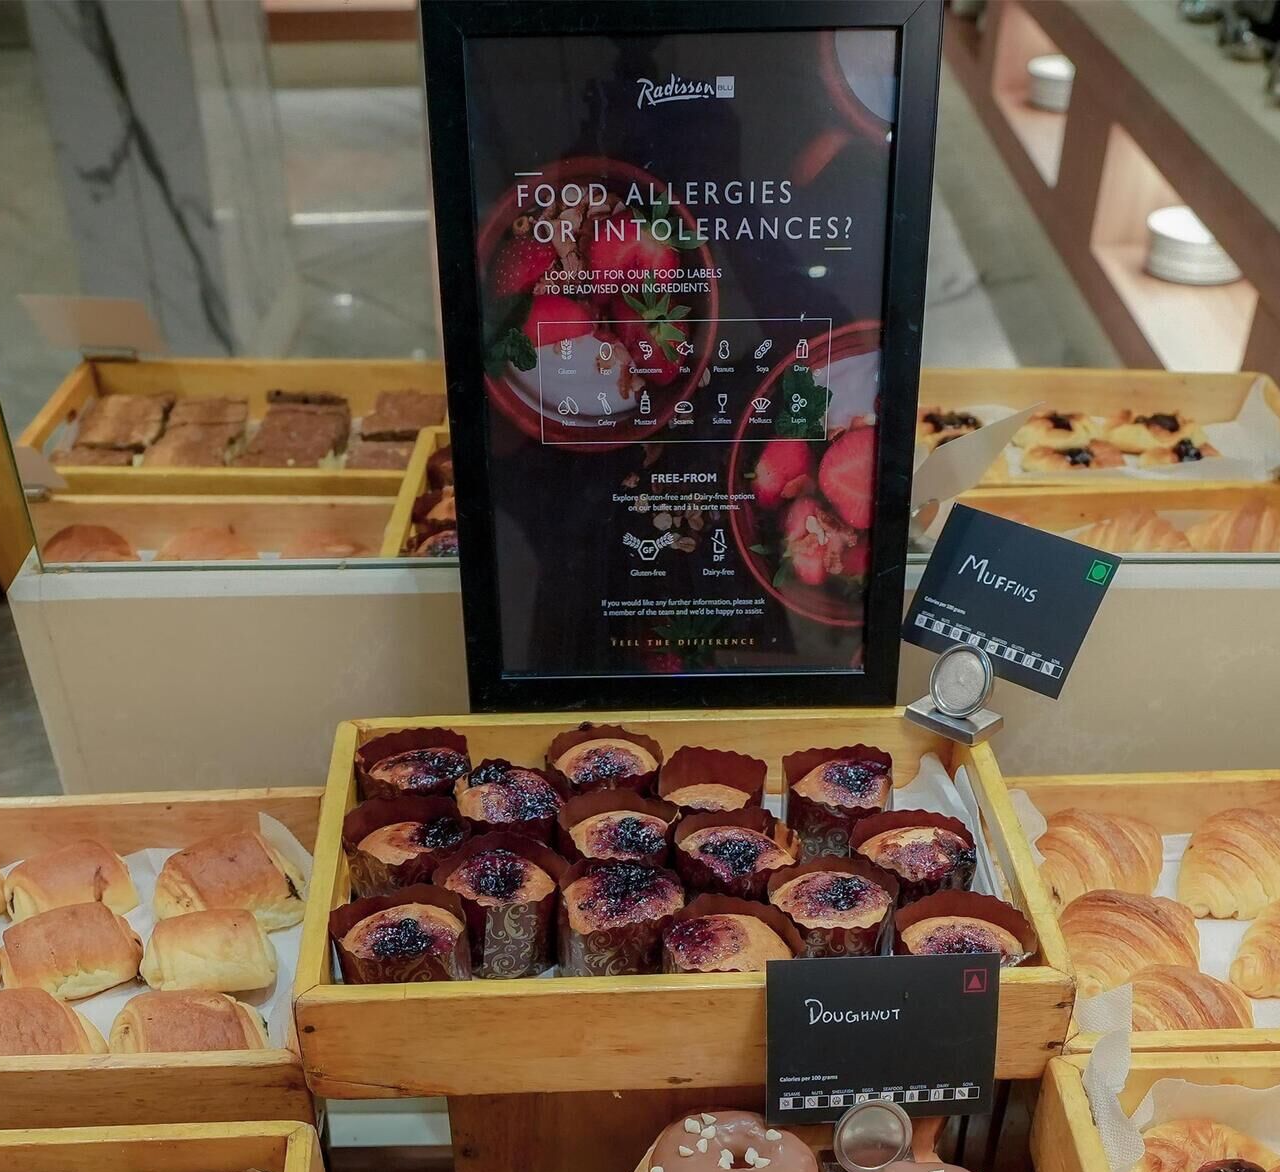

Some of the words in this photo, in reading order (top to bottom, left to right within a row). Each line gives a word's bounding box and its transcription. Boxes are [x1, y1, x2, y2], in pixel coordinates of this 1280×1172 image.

[636, 73, 715, 110] Radisson
[517, 183, 608, 207] FOOD
[625, 180, 792, 206] ALLERGIES
[533, 219, 576, 243] OR
[594, 215, 853, 242] INTOLERANCES?
[544, 270, 576, 281] LOOK
[578, 270, 601, 280] OUT
[604, 269, 624, 280] FOR
[627, 269, 650, 280] OUR
[653, 268, 685, 280] FOOD
[687, 268, 722, 279] LABELS
[546, 284, 560, 295] TO
[564, 284, 576, 294] BE
[576, 284, 619, 294] ADVISED
[621, 284, 639, 294] ON
[642, 282, 712, 294] INGREDIENTS.
[756, 366, 770, 374] Soya
[794, 365, 810, 374] Dairy
[791, 416, 806, 424] Lupin
[651, 473, 718, 484] FREE-FROM
[612, 494, 638, 502] Explore
[640, 493, 679, 501] Gluten-free
[694, 493, 729, 502] Dairy-free
[730, 493, 756, 502] options
[703, 569, 735, 577] Dairy-free
[733, 598, 752, 606] please
[716, 608, 734, 616] happy
[804, 999, 900, 1025] DOUGHNUT
